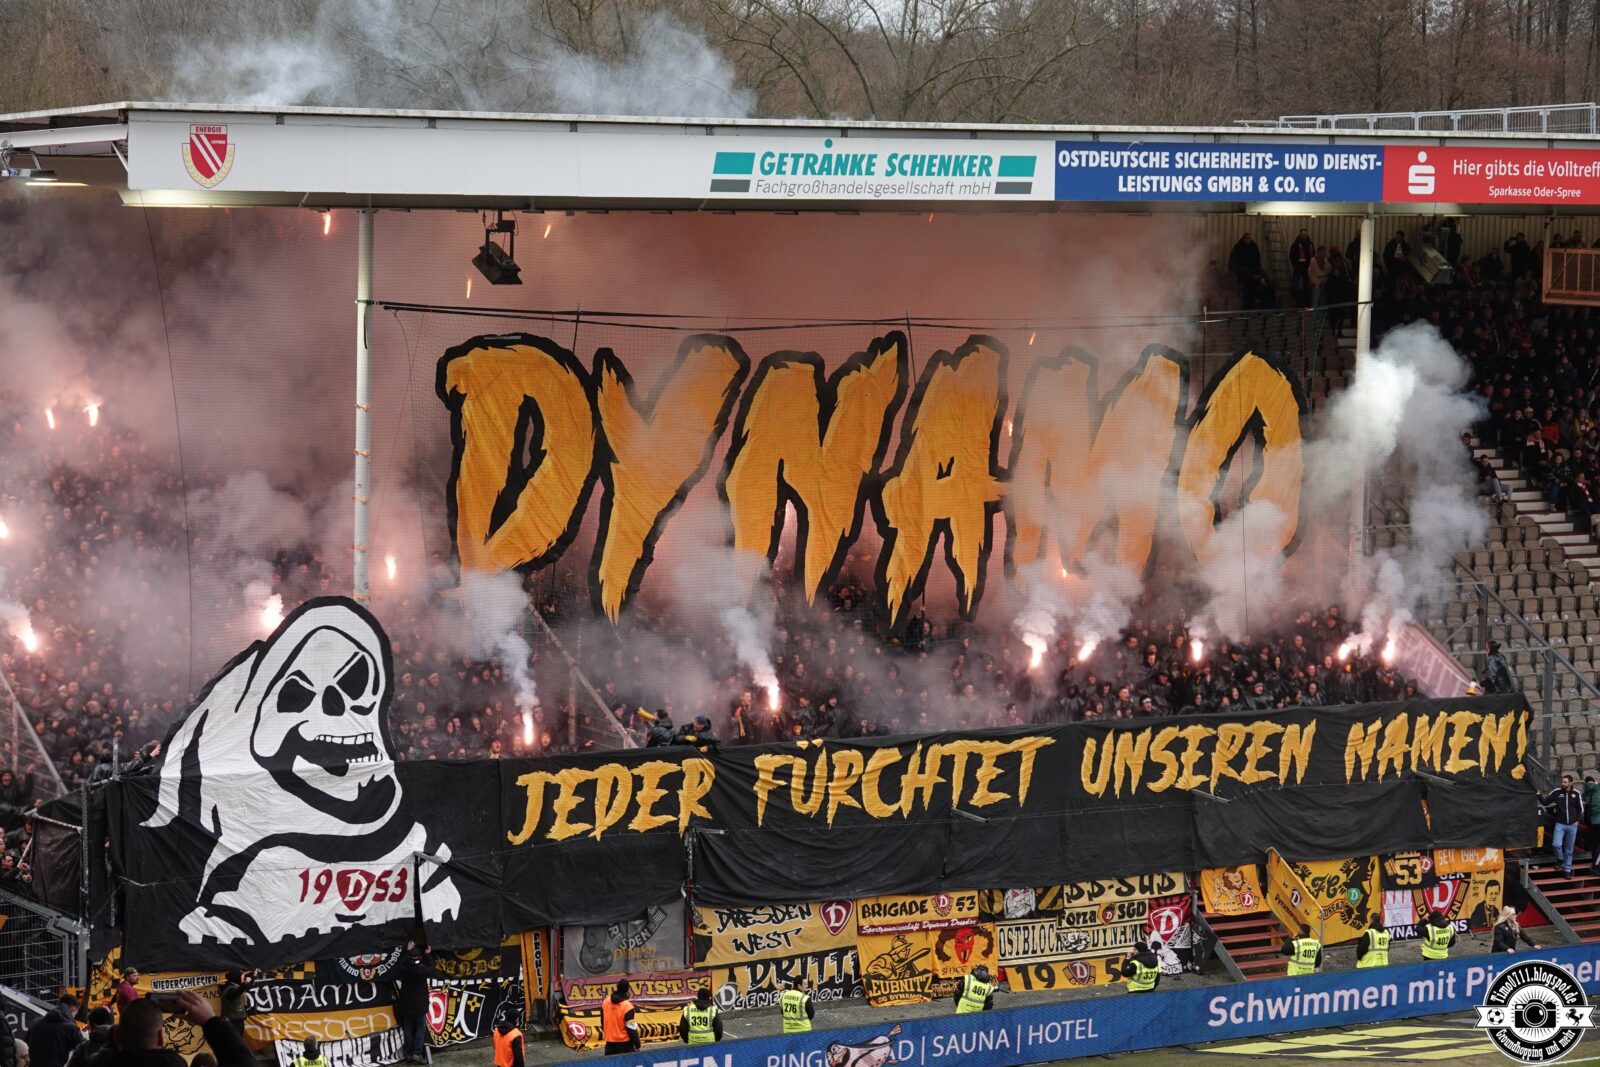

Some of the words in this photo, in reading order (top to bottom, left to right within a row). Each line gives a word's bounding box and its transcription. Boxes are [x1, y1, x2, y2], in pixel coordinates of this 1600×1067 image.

[885, 152, 993, 177] SCHENKER
[1058, 149, 1170, 169] OSTDEUTSCHE
[1175, 151, 1279, 169] SICHERHEITS-
[1284, 153, 1319, 170] UND
[1323, 153, 1382, 171] DIENST-
[1453, 159, 1480, 176] Hier
[1485, 160, 1520, 180] gibts
[1523, 160, 1544, 177] die
[755, 180, 953, 198] Fachgroßhandelsgesellschaft
[959, 181, 991, 195] mbH
[1118, 175, 1202, 193] LEISTUNGS
[1207, 176, 1252, 193] GMBH
[1257, 176, 1269, 193] &
[1274, 176, 1299, 193] CO.
[1304, 177, 1326, 193] KG
[1488, 186, 1532, 198] Sparkasse
[1533, 187, 1581, 199] Oder-Spree
[435, 330, 1306, 630] DYNAMO
[507, 757, 716, 846] JEDER
[753, 736, 1057, 830] FÜRCHTET
[1080, 718, 1317, 799] UNSEREN
[1344, 709, 1530, 782] NAMEN!
[1395, 858, 1422, 886] 53
[298, 867, 333, 905] 19
[372, 867, 409, 903] 53
[714, 902, 812, 933] DRESDEN
[861, 899, 929, 919] BRIGADE
[955, 895, 977, 912] 53
[1117, 902, 1147, 920] SGD
[732, 927, 803, 955] WEST
[1302, 949, 1316, 958] 403
[152, 975, 219, 991] NIEDERSCHLESIEN
[864, 973, 933, 997] LEUBNITZ
[1014, 964, 1056, 991] 19
[568, 979, 684, 1001] AKTVIST
[1207, 983, 1398, 1028] Schwimmen
[1408, 970, 1456, 1003] mit
[784, 1003, 798, 1014] 276
[691, 1016, 708, 1027] 339
[931, 1028, 1010, 1058] SAUNA
[1028, 1017, 1098, 1046] HOTEL
